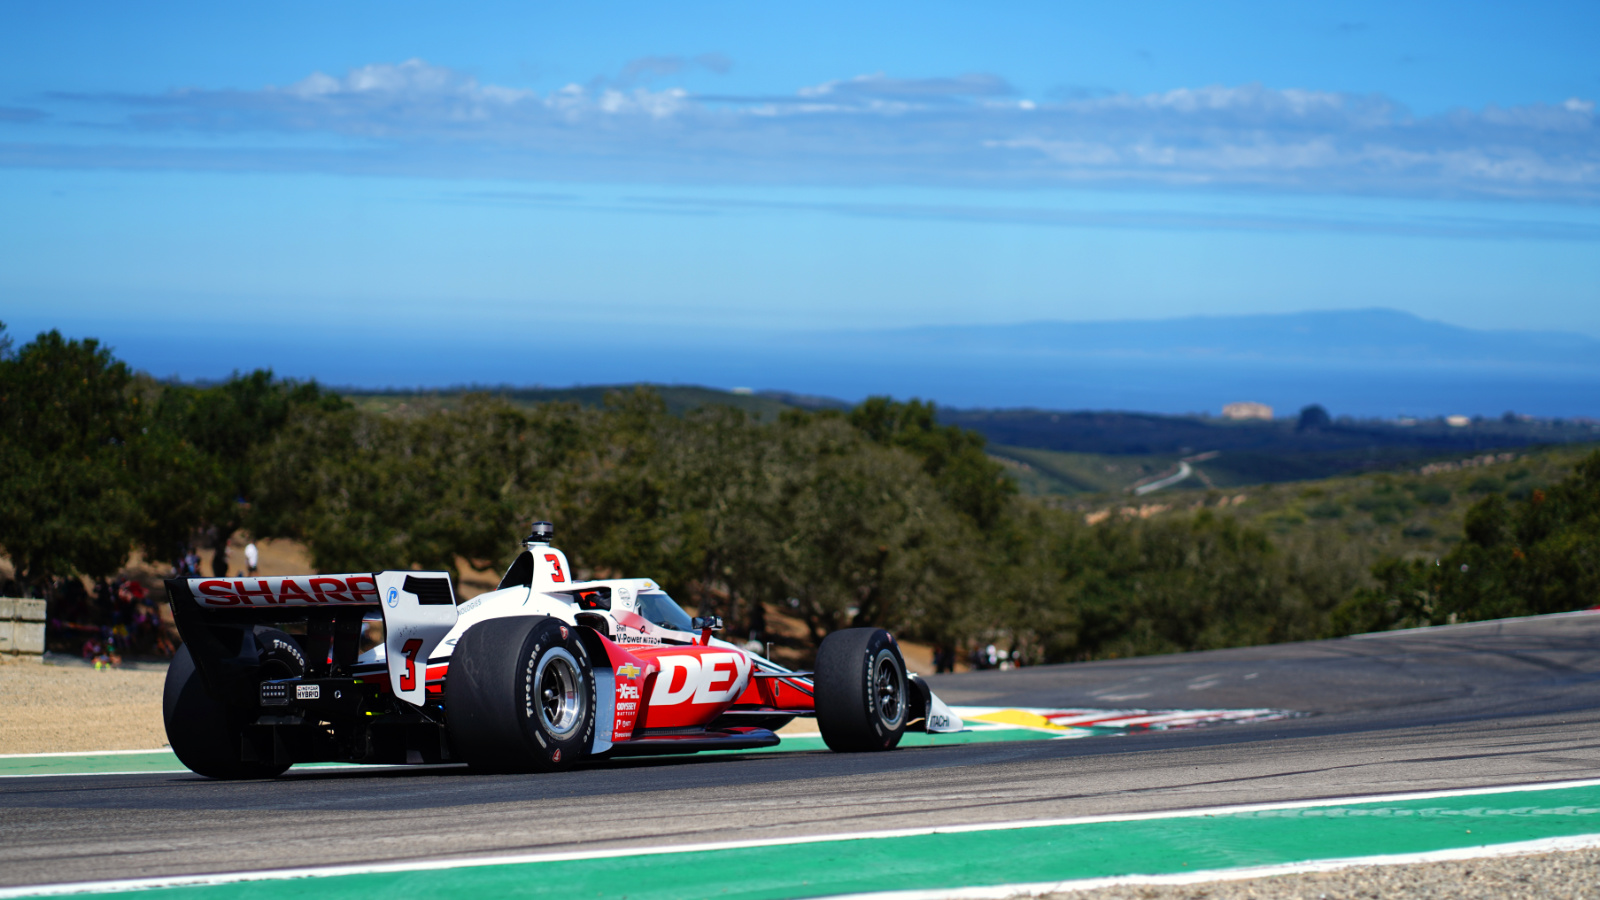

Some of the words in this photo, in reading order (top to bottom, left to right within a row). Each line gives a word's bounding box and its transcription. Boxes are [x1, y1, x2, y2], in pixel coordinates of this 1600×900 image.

[544, 554, 565, 582] 3
[198, 577, 377, 606] SHARP
[616, 624, 627, 632] Shell
[616, 633, 642, 643] V-Power
[273, 639, 305, 670] Firesto
[400, 638, 423, 692] 3
[297, 690, 319, 698] HYBRID
[525, 643, 541, 718] Firestone
[619, 683, 640, 699] XPEL
[584, 669, 597, 742] Firestone
[617, 702, 637, 711] ODYSSEY
